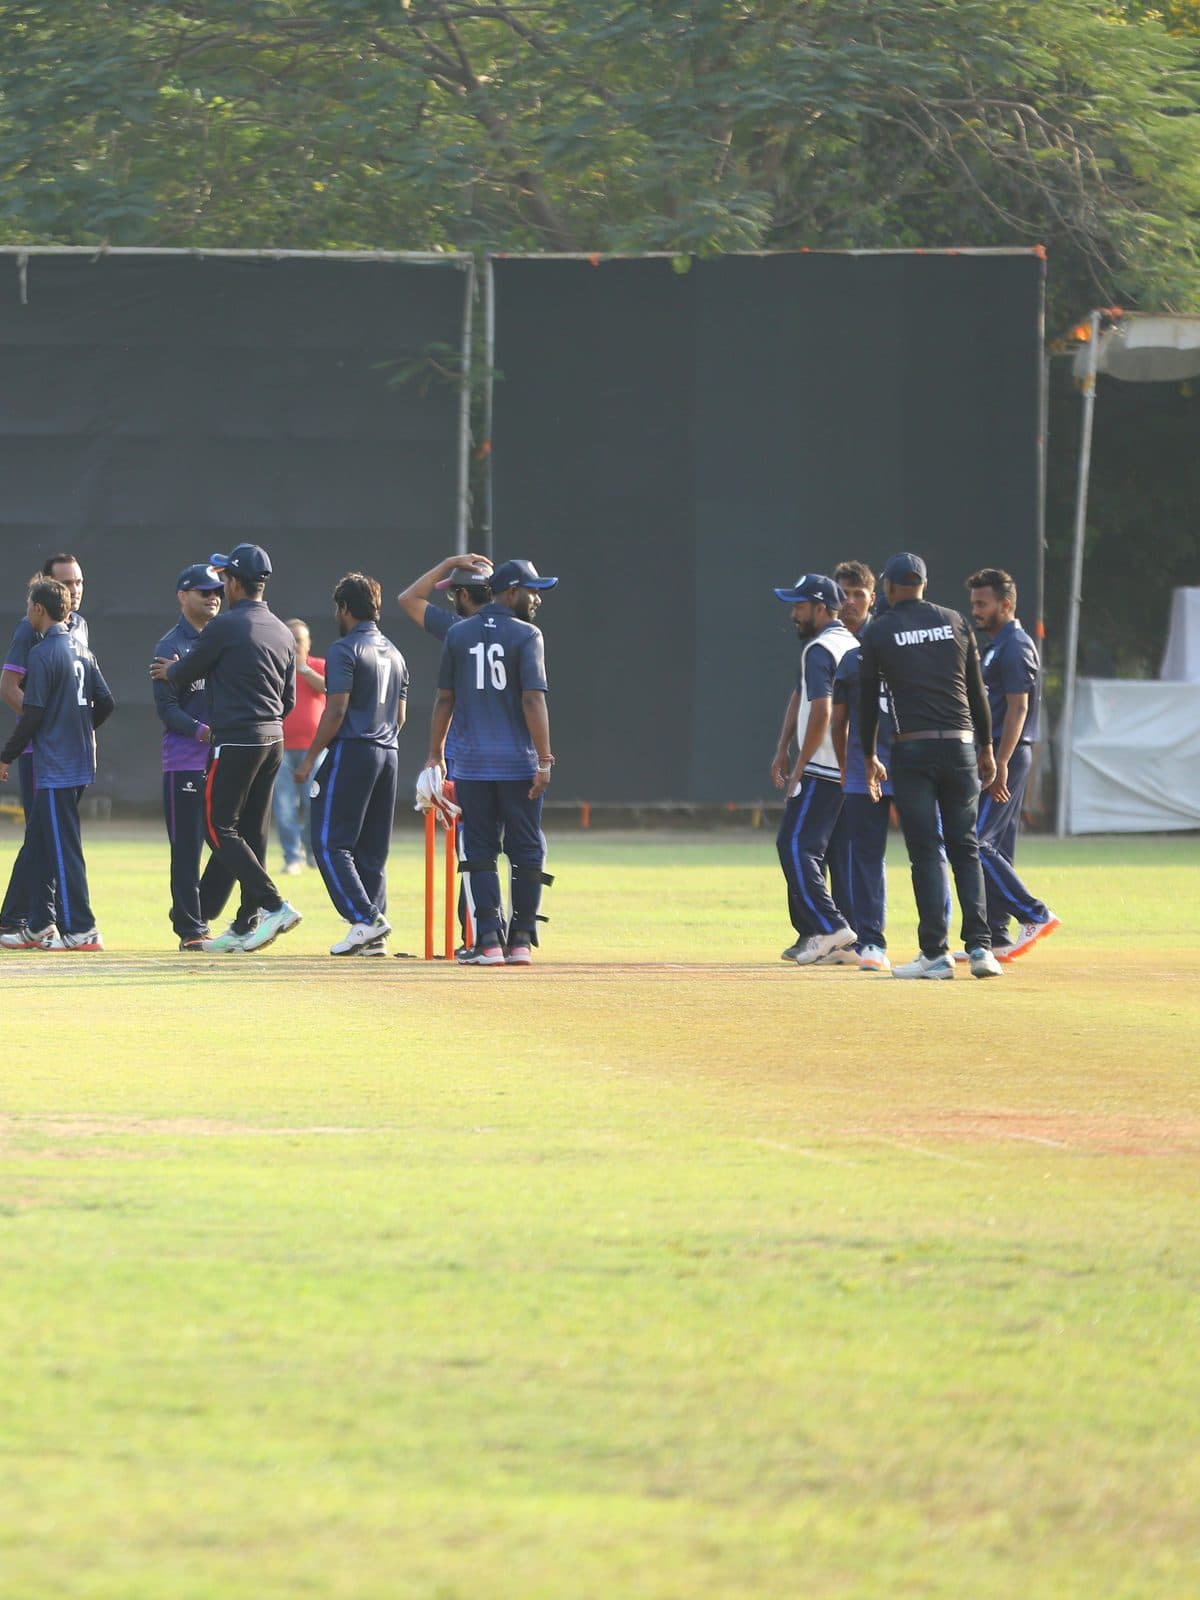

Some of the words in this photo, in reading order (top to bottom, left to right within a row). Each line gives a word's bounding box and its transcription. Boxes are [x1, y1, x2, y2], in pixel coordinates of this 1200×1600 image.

[894, 625, 954, 646] UMPIRE
[73, 660, 88, 706] 2
[469, 642, 507, 691] 16
